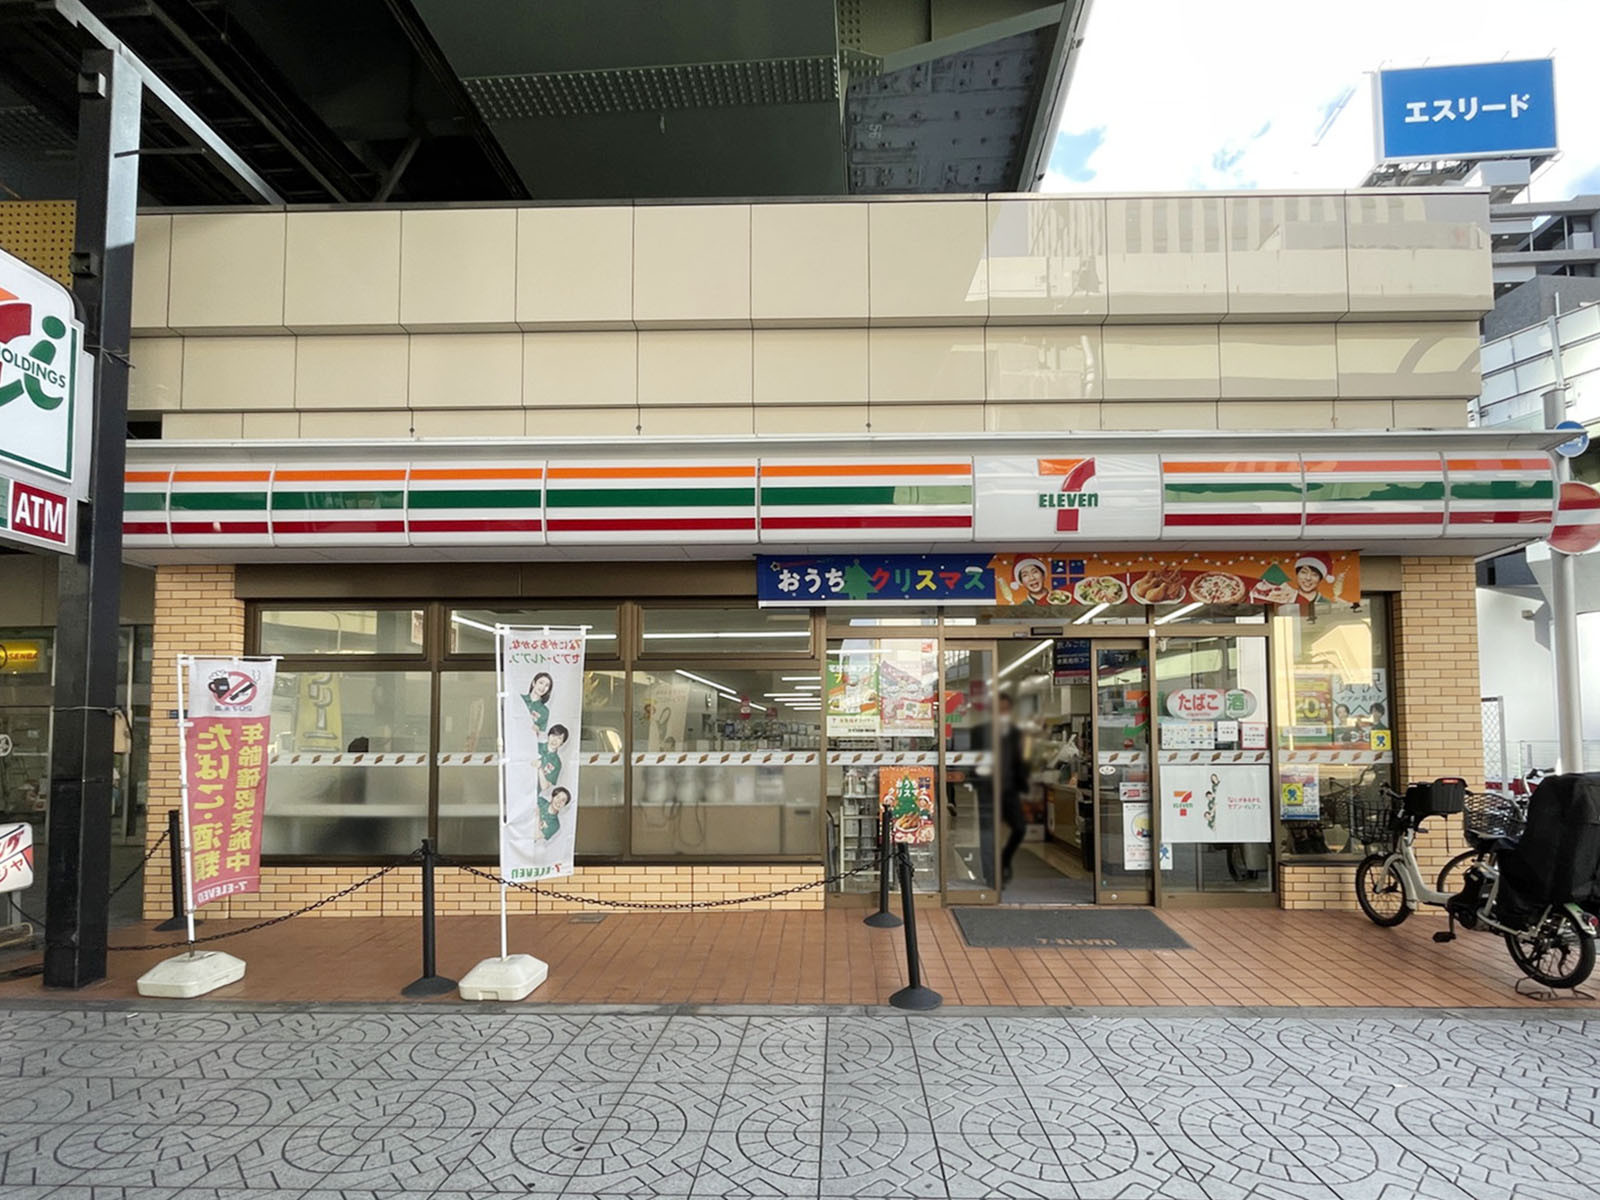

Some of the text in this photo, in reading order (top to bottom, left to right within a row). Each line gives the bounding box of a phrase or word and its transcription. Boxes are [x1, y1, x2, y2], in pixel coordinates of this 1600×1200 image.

[1404, 93, 1530, 123] エスリード
[0, 345, 66, 388] OLDINGS
[1037, 457, 1095, 531] 7
[15, 492, 63, 535] ATM
[778, 567, 986, 593] おうち クリスマス
[1178, 693, 1219, 711] たばこ
[1227, 693, 1245, 711] 酒
